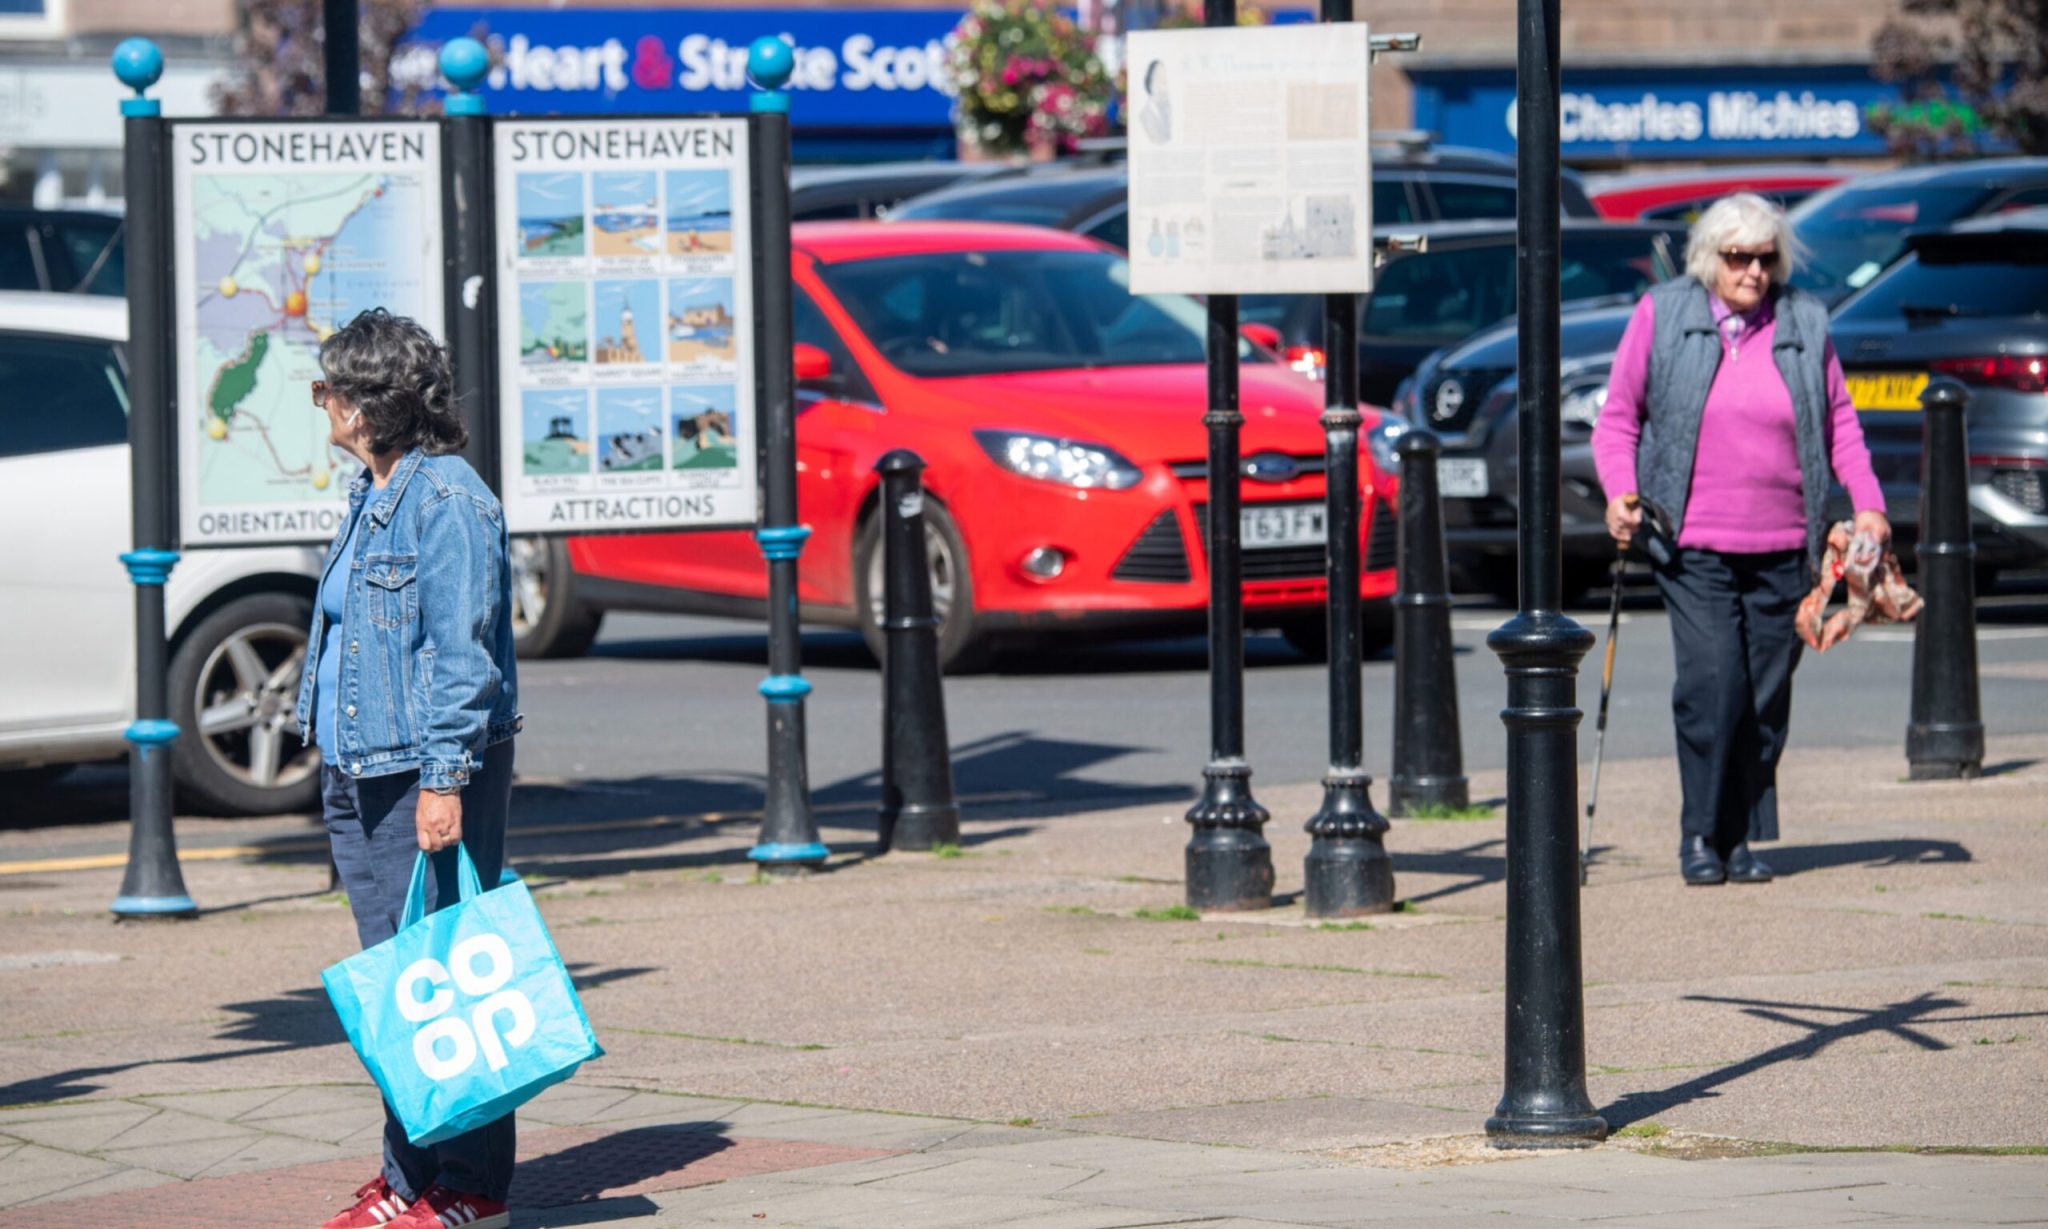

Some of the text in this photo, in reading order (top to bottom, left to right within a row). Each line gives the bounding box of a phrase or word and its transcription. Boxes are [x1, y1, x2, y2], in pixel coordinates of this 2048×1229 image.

[487, 33, 629, 91] Heart
[632, 34, 674, 90] &
[679, 33, 838, 91] Strke
[1560, 92, 1703, 142] Charles
[1707, 90, 1861, 140] Michies
[191, 132, 425, 164] STONEHAVEN
[512, 128, 734, 160] STONEHAVEN
[550, 494, 716, 522] ATTRACTIONS
[1241, 509, 1287, 540] T63
